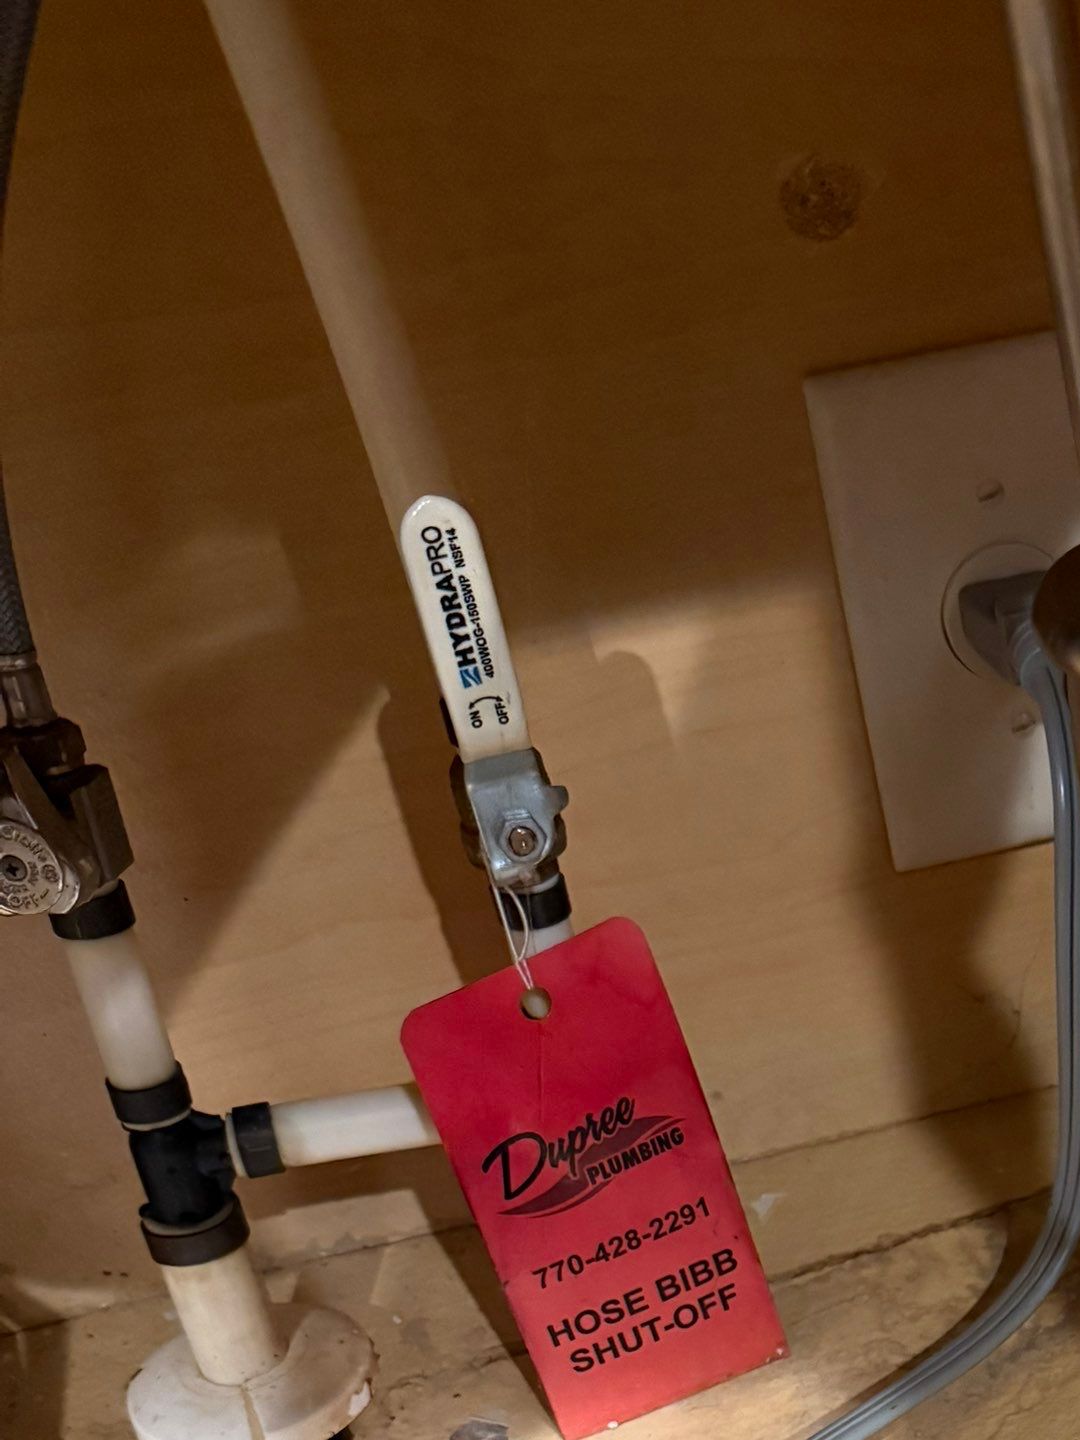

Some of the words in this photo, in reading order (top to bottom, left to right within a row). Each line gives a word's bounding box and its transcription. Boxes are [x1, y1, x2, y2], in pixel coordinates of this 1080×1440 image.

[445, 527, 466, 568] NSF14
[421, 526, 477, 667] HYDRAPRO
[458, 575, 494, 679] 400WOG-150SWP
[470, 709, 483, 729] ON
[495, 702, 509, 724] OFF
[481, 1096, 635, 1200] Dupree
[586, 1126, 685, 1186] PLUMBING
[531, 1197, 710, 1289] 770-428-2291
[547, 1286, 649, 1347] HOSE
[655, 1247, 739, 1303] BIBB
[569, 1283, 738, 1374] SHUT-OFF
